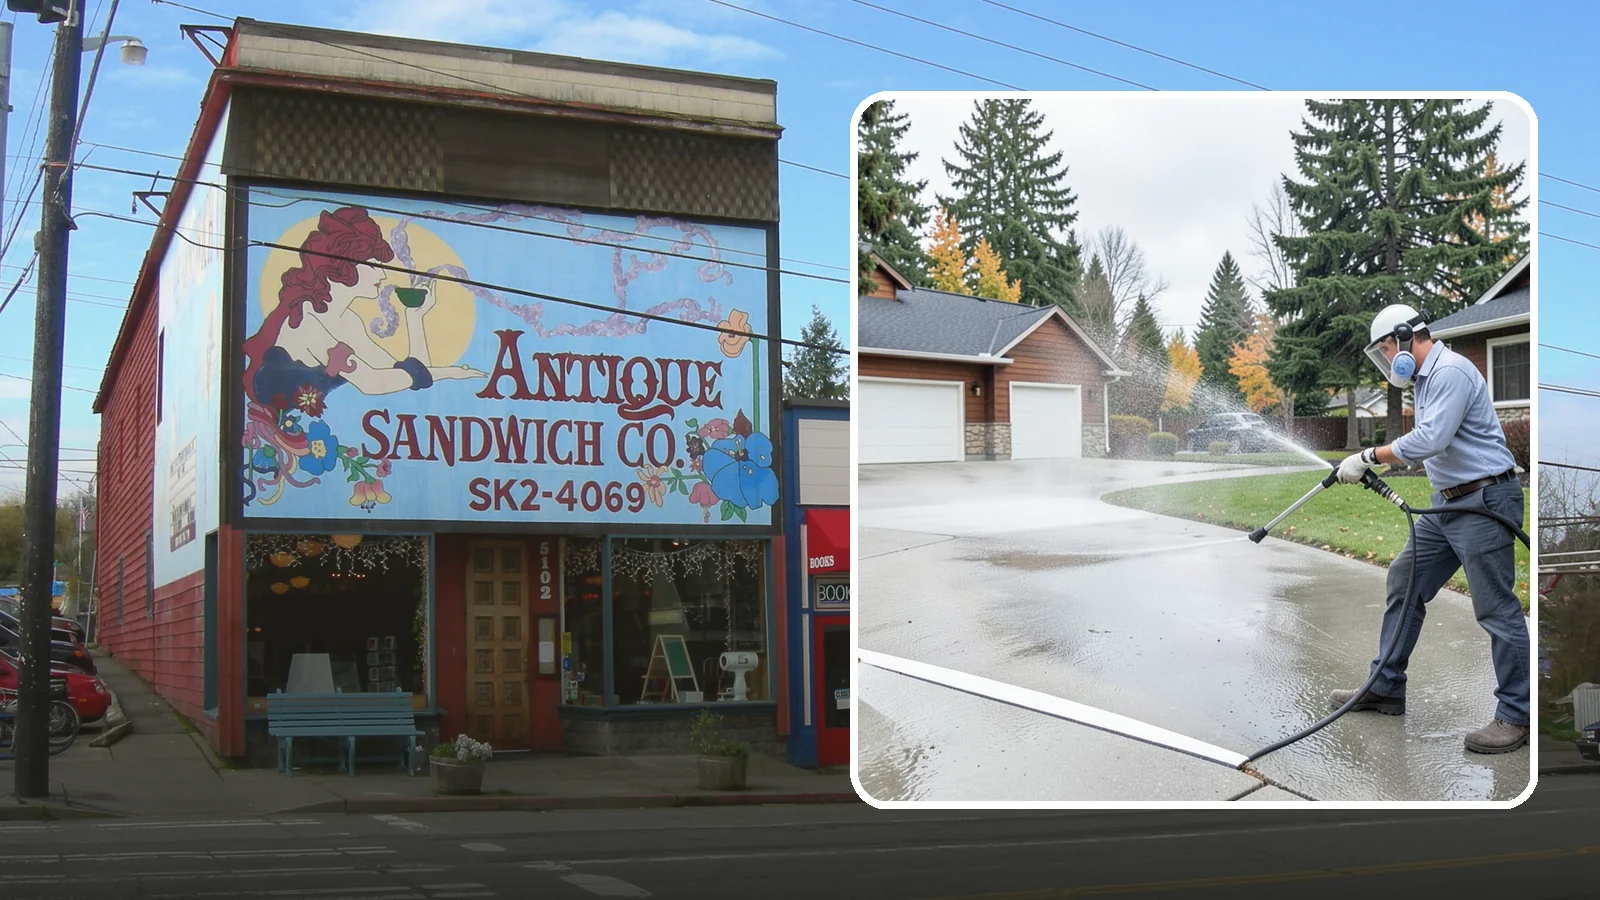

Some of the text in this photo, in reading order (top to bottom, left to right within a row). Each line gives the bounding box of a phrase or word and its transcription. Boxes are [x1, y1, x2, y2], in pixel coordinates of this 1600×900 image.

[475, 329, 724, 421] ANTIQUE
[361, 408, 685, 468] SANDWICH CO.
[468, 477, 646, 513] SK2-4069
[539, 542, 552, 600] 5102
[810, 555, 835, 569] BOOKS
